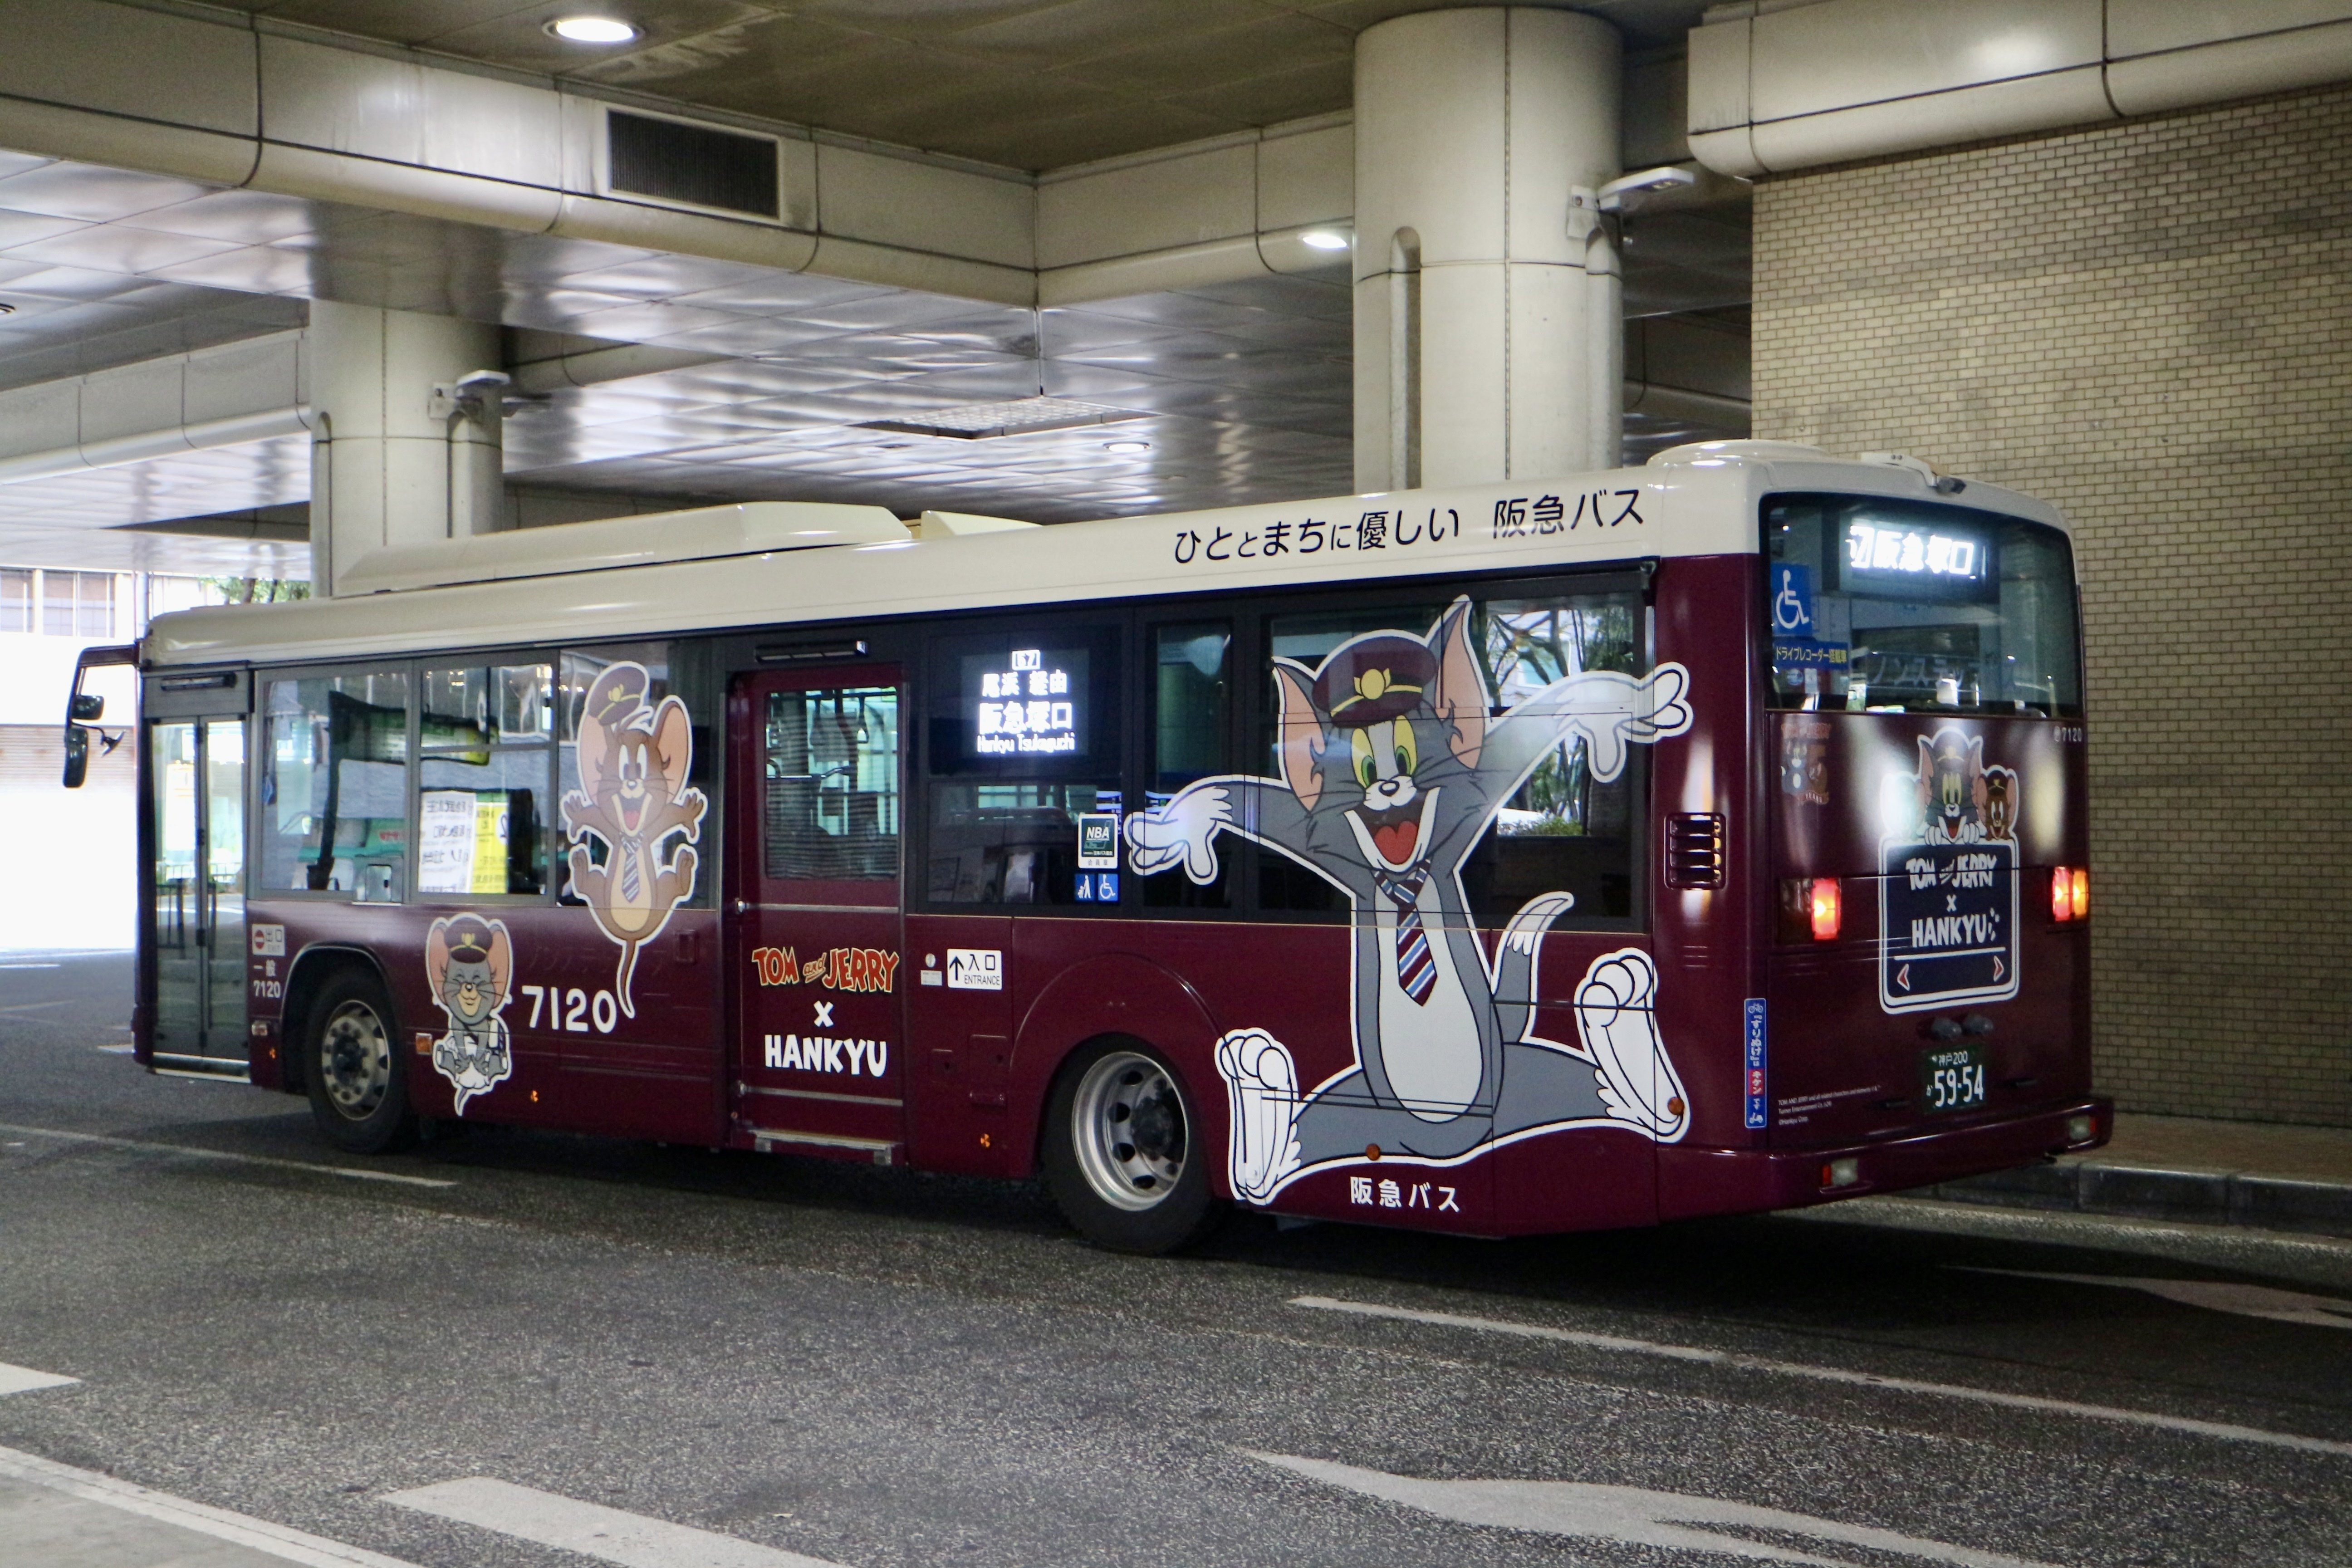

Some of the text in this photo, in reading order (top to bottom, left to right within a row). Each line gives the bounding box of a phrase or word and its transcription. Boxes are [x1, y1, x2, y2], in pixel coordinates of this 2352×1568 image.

[1174, 489, 1645, 564] ひととまちに優しい 阪急バス
[979, 701, 1072, 735] 阪急塚口
[977, 731, 1075, 755] Hankyu Tsukaguchi
[1086, 826, 1110, 839] NBA
[1906, 858, 1937, 891] TOM
[1951, 853, 1997, 889] JERRY
[1911, 914, 1987, 948] HANKYU
[751, 946, 900, 993] TOM and JERRY
[968, 954, 996, 971] 入口
[253, 980, 281, 998] 7120
[964, 975, 1000, 985] ENTRANCE
[522, 985, 617, 1034] 7120
[764, 1034, 887, 1078] HANKYU
[1350, 1176, 1460, 1213] 阪急バス
